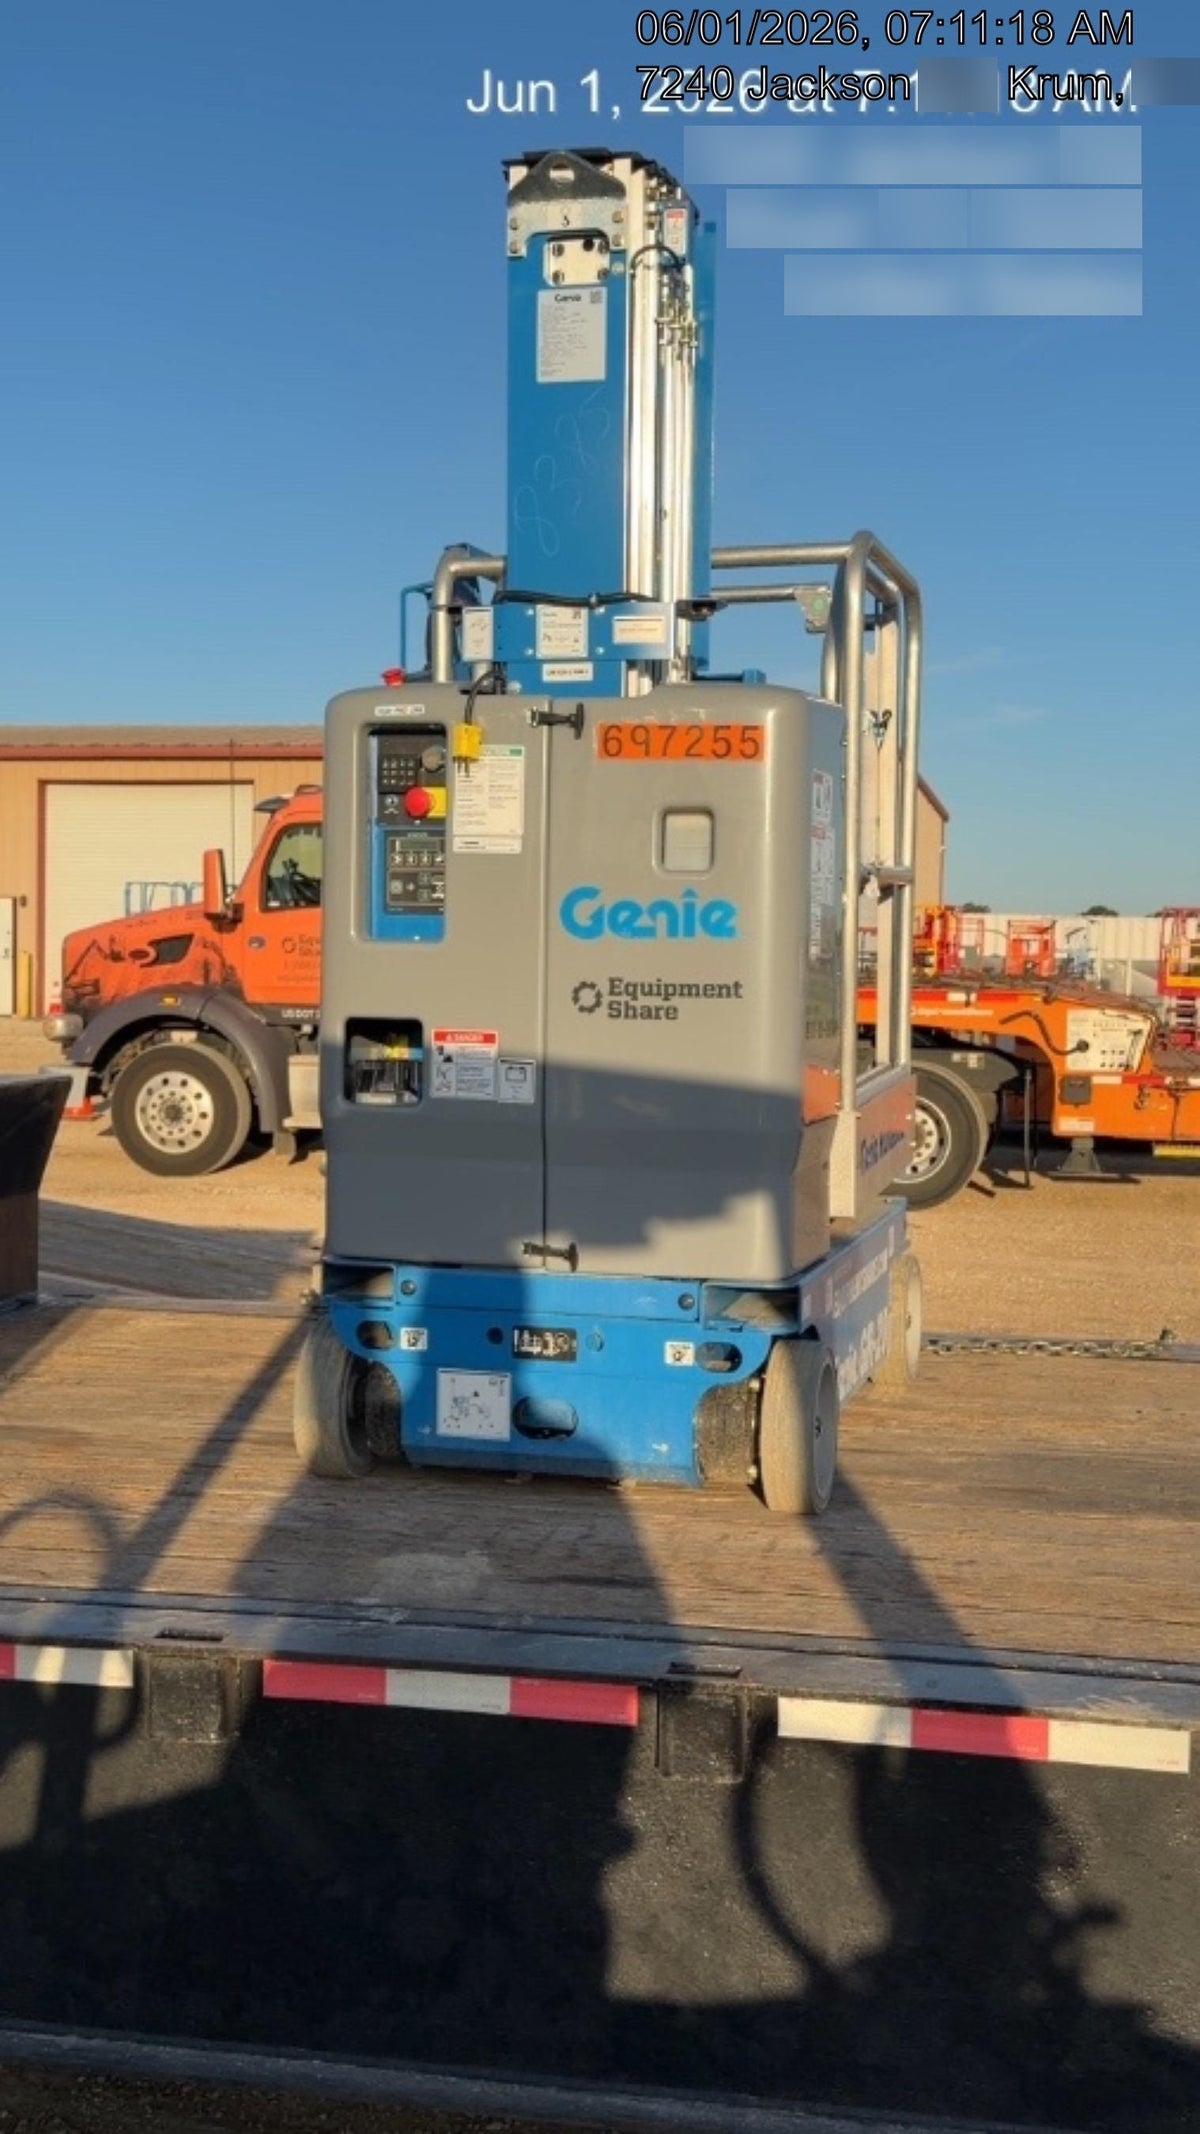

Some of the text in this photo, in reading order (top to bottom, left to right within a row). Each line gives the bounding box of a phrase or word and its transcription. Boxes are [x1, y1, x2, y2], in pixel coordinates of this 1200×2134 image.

[602, 724, 761, 760] 697255
[559, 886, 739, 940] Genie
[607, 977, 743, 1000] Equipment
[607, 1000, 679, 1020] Share
